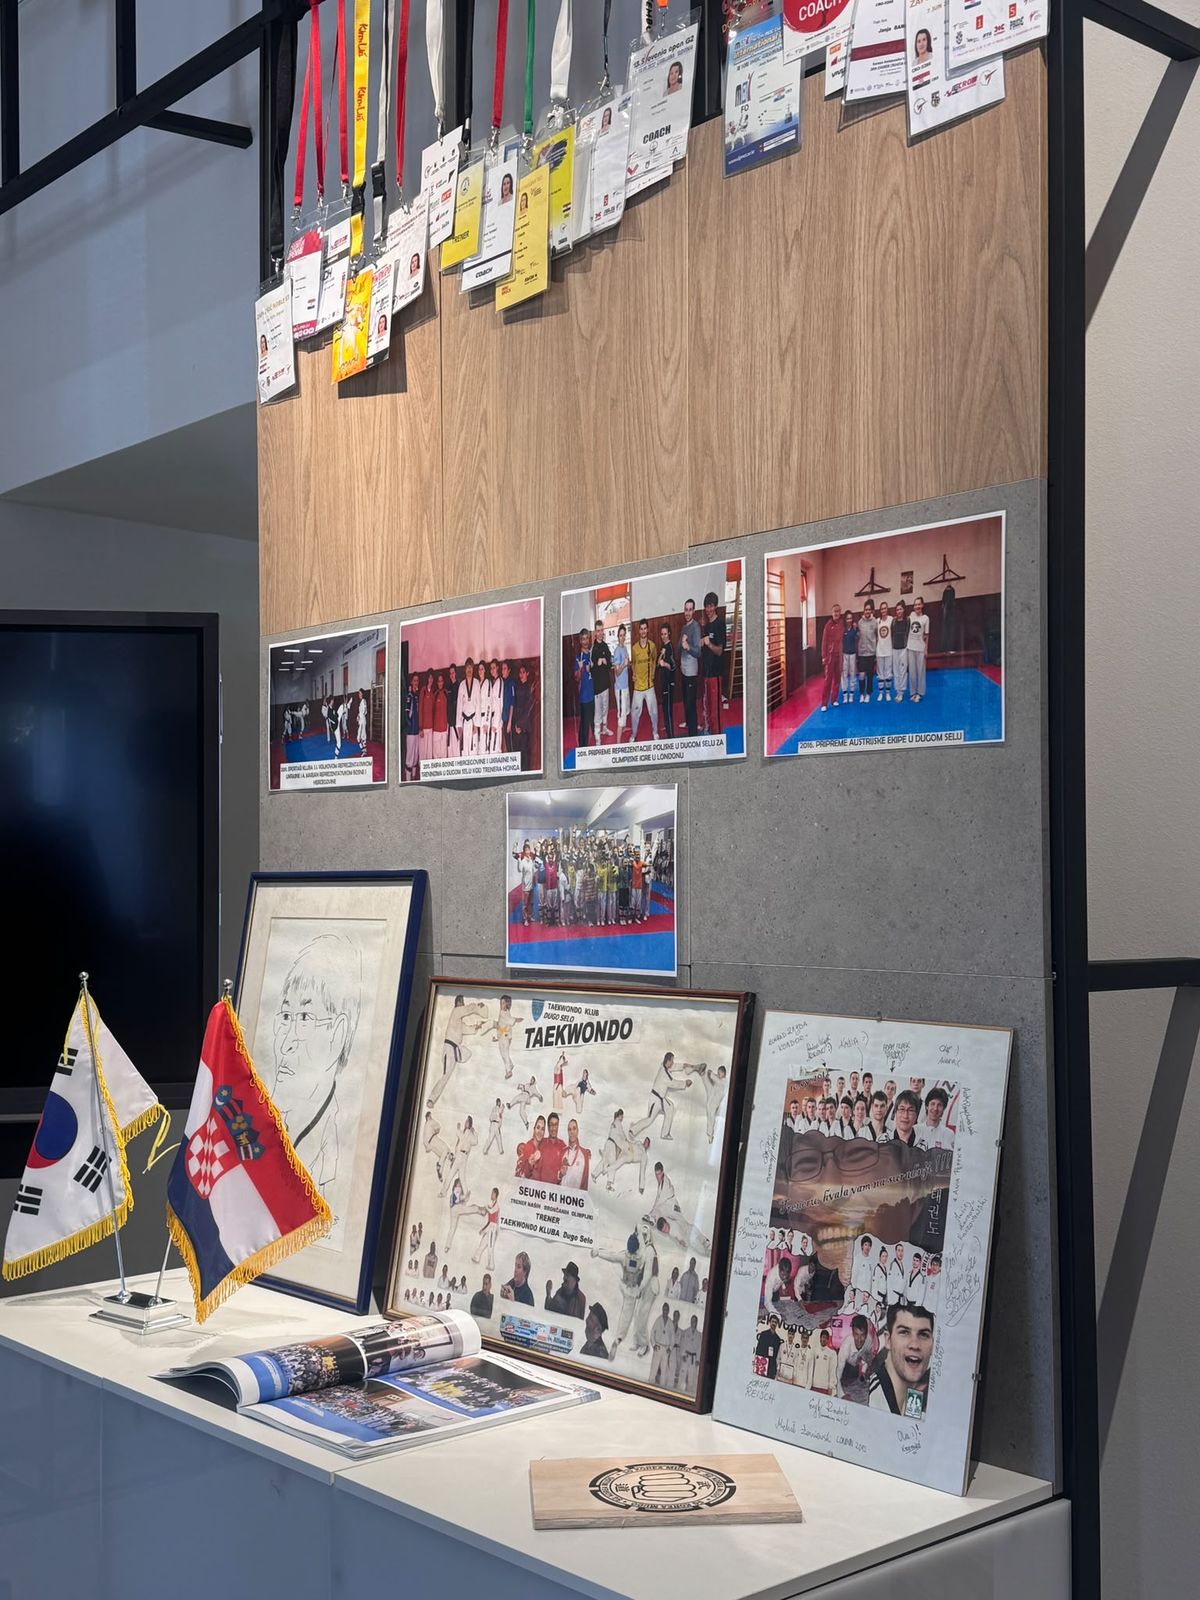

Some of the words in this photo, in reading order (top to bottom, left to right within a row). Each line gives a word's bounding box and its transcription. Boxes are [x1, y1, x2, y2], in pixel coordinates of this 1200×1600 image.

[668, 41, 684, 54] open
[642, 124, 671, 144] COACH
[475, 266, 493, 279] COACH
[816, 740, 847, 748] PRIPREME
[849, 737, 887, 746] AUSTRIJSKE
[887, 735, 907, 744] EKIPE
[915, 733, 943, 742] DUGOM
[944, 732, 962, 741] SELU
[588, 748, 611, 756] PRIPREME
[612, 745, 652, 755] REPREZENTACIJE
[680, 740, 701, 749] DUGOM
[702, 739, 715, 747] SELU
[639, 754, 651, 762] IGRE
[657, 752, 684, 760] LONDONU
[482, 765, 502, 773] TRENERA
[502, 764, 520, 772] HONGA
[548, 1003, 582, 1014] TAEKWONDO
[585, 1008, 600, 1016] KLUB
[543, 1012, 559, 1020] DUGO
[560, 1014, 575, 1022] SELO
[525, 1018, 633, 1048] TAEKWONDO
[849, 1183, 871, 1195] vam
[873, 1179, 885, 1189] na
[510, 1198, 527, 1207] TRENER
[519, 1186, 546, 1200] SEUNG
[549, 1192, 557, 1202] KI
[560, 1194, 584, 1208] HONG
[536, 1213, 560, 1224] TRENER
[927, 1188, 942, 1235] 태권도
[500, 1217, 538, 1232] TAEKWONDO
[539, 1225, 560, 1237] KLUBA
[563, 1231, 578, 1241] Dugo
[580, 1235, 593, 1245] Selo
